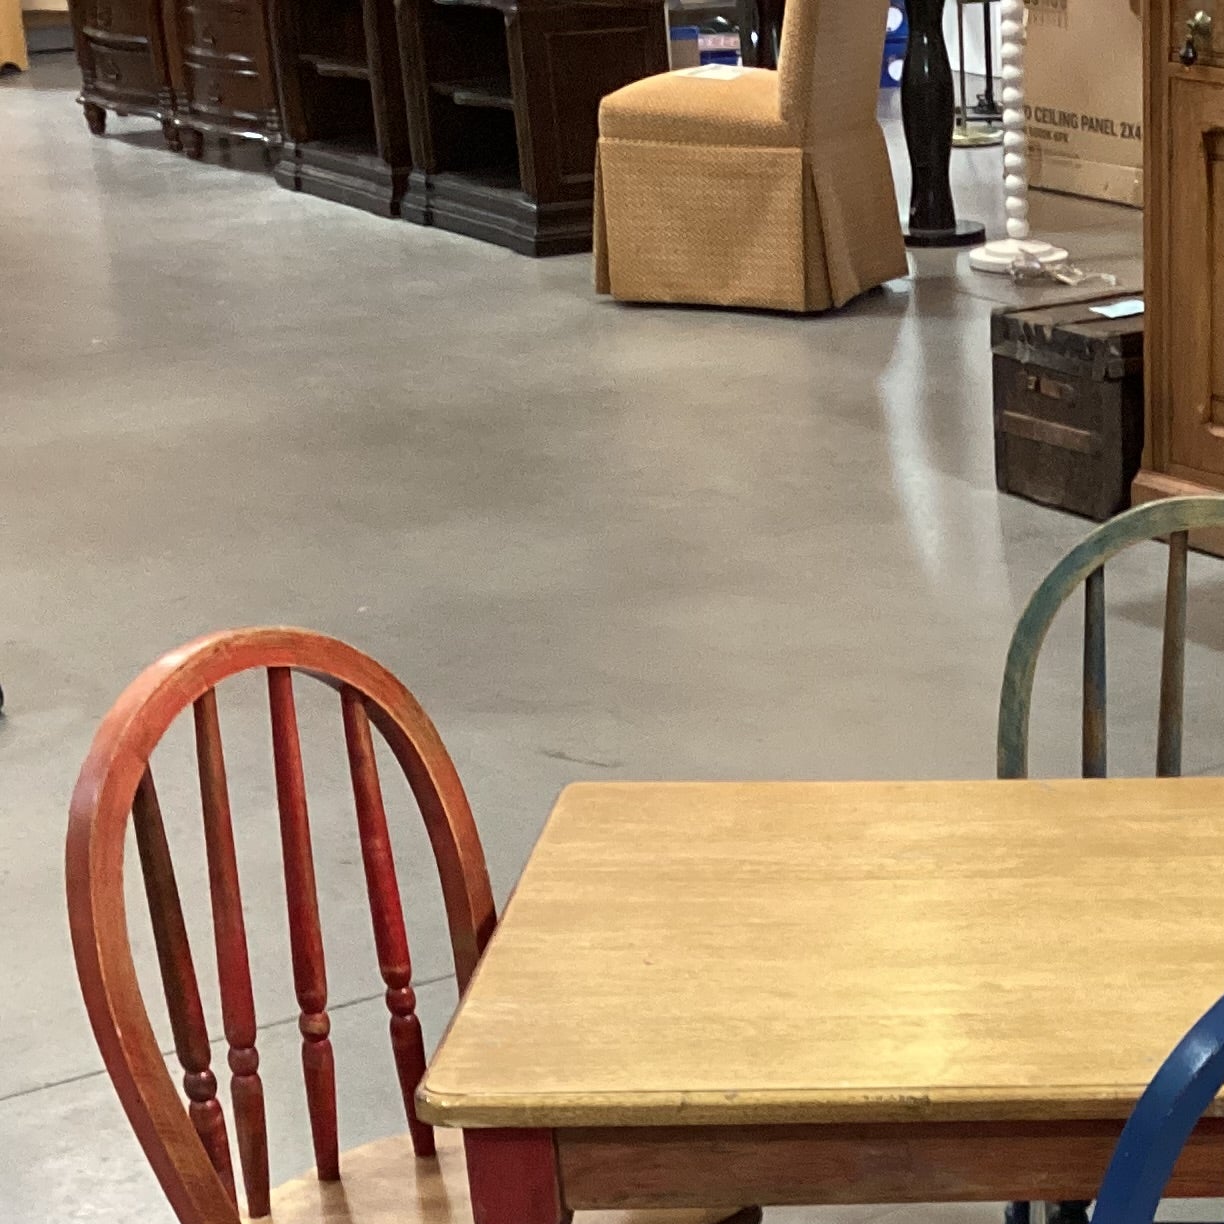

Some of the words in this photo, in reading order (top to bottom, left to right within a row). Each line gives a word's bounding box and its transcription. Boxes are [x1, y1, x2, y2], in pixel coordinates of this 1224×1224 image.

[1034, 106, 1079, 129] CEILING
[1081, 115, 1118, 136] PANEL
[1120, 120, 1142, 140] 2X4
